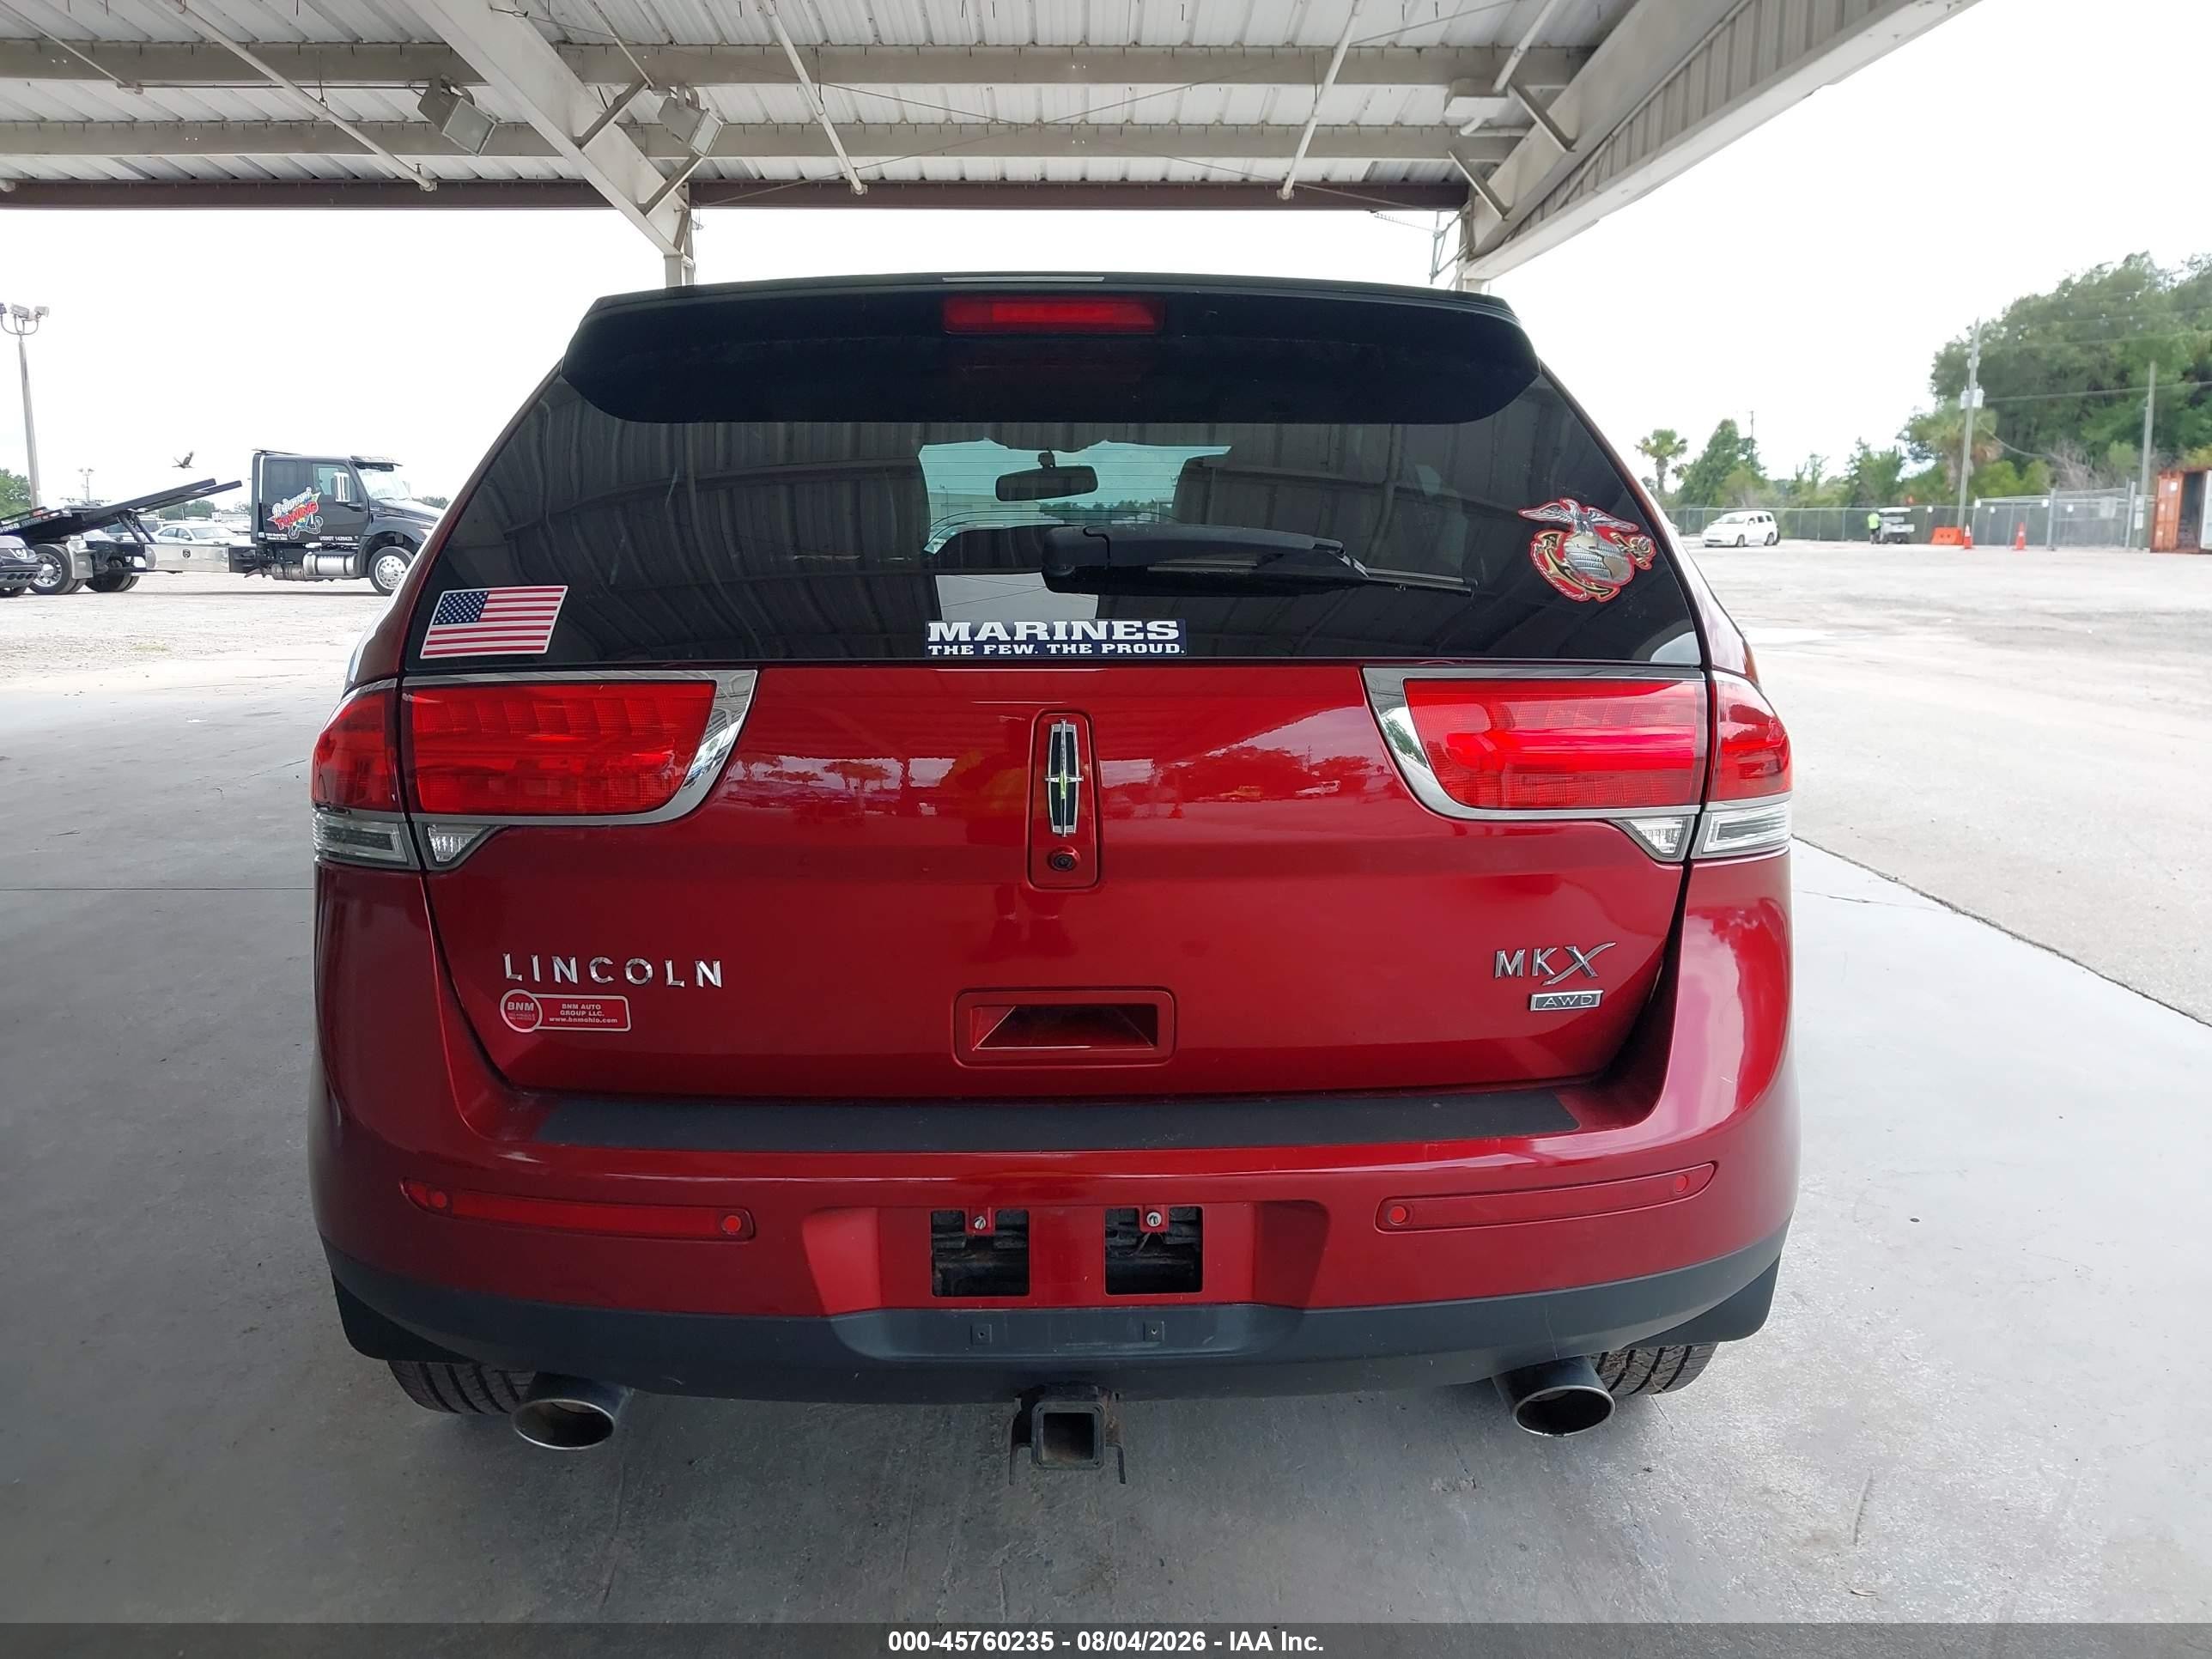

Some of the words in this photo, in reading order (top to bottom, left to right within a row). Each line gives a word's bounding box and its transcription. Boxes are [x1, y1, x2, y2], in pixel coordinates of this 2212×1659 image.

[275, 501, 318, 530] TOWING
[927, 621, 1179, 641] MARINES
[927, 644, 974, 655] THE
[983, 644, 1038, 655] FEW.
[1047, 643, 1093, 654] THE
[1101, 643, 1185, 654] PROUD.
[502, 952, 723, 988] LINCOLN
[1494, 941, 1617, 987] MKX
[507, 1001, 534, 1012] BNM
[1542, 994, 1594, 1007] AWD
